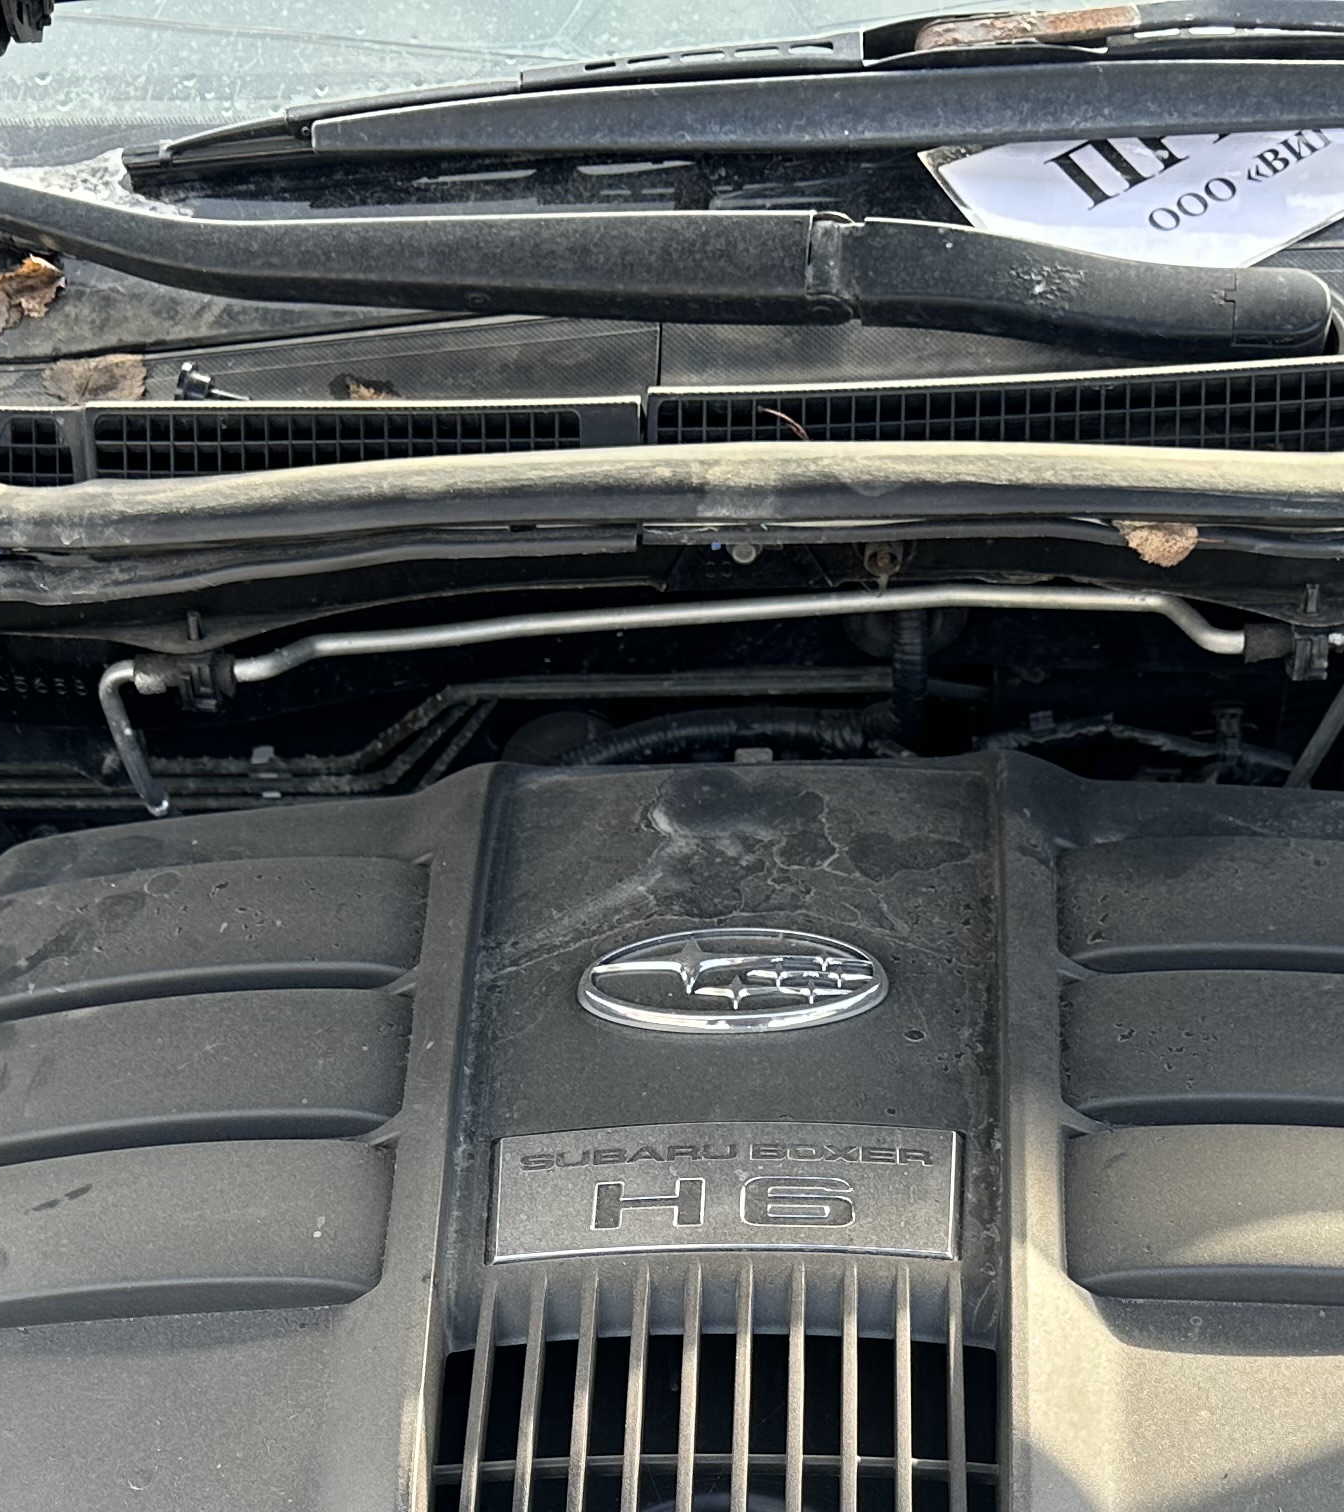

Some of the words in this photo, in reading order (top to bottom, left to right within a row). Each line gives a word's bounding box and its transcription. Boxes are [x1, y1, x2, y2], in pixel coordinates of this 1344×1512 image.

[1148, 176, 1237, 231] ООО
[520, 1142, 738, 1173] SUBARU
[749, 1142, 935, 1167] BOXER
